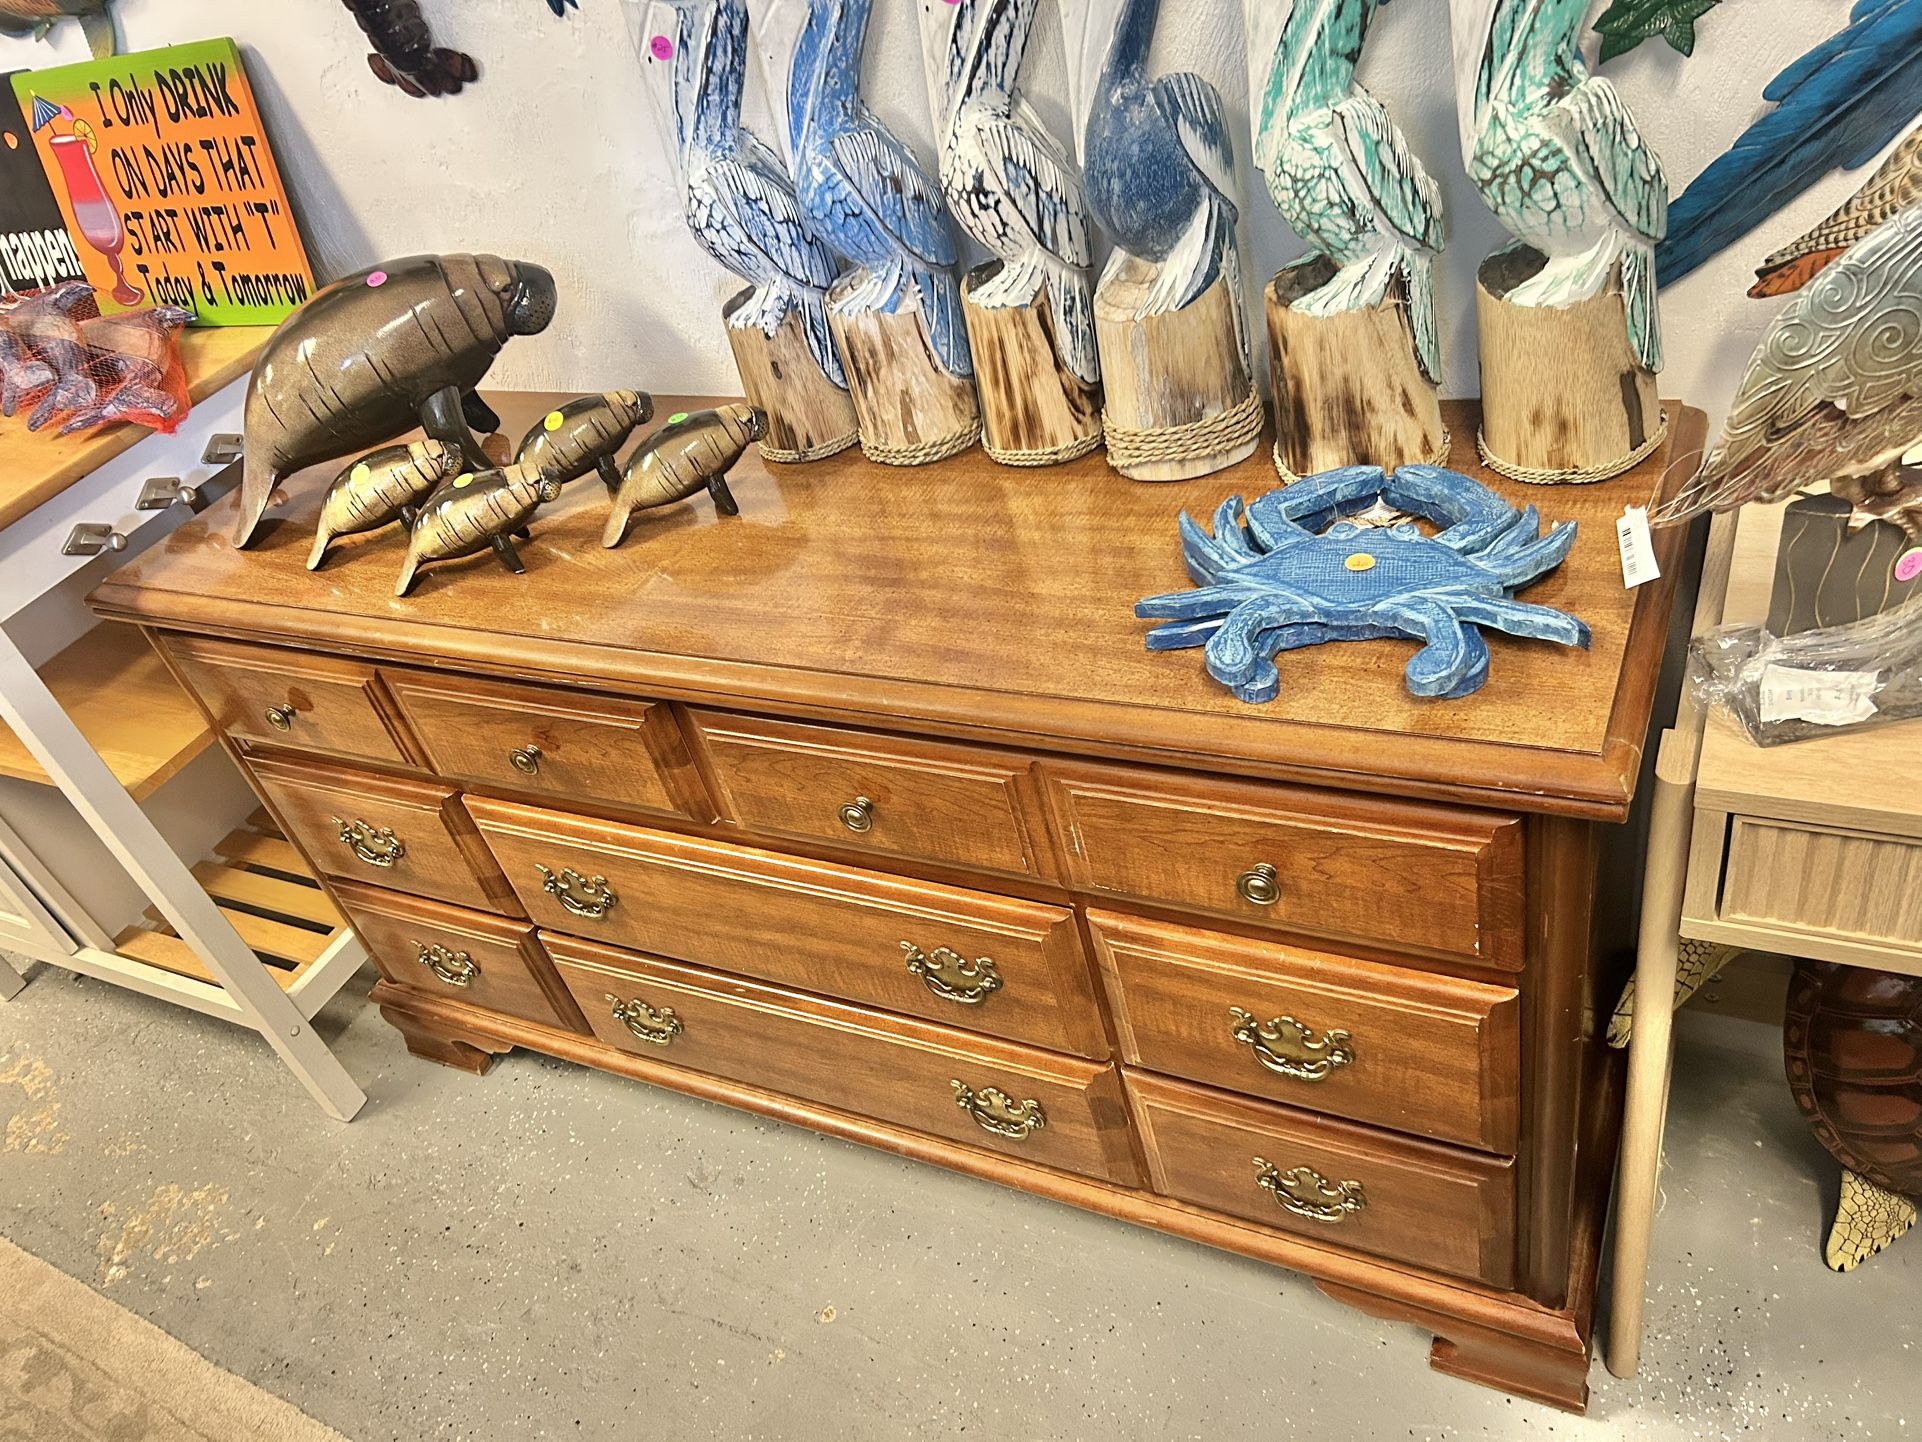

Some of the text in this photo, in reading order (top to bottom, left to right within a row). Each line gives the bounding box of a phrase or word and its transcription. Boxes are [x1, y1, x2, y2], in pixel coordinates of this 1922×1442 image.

[89, 62, 240, 139] I Only DRINK
[111, 135, 265, 200] ON DAYS THAT
[123, 199, 280, 256] START WITH "T"
[0, 228, 84, 293] happen
[136, 260, 307, 318] Today & Tomorrow
